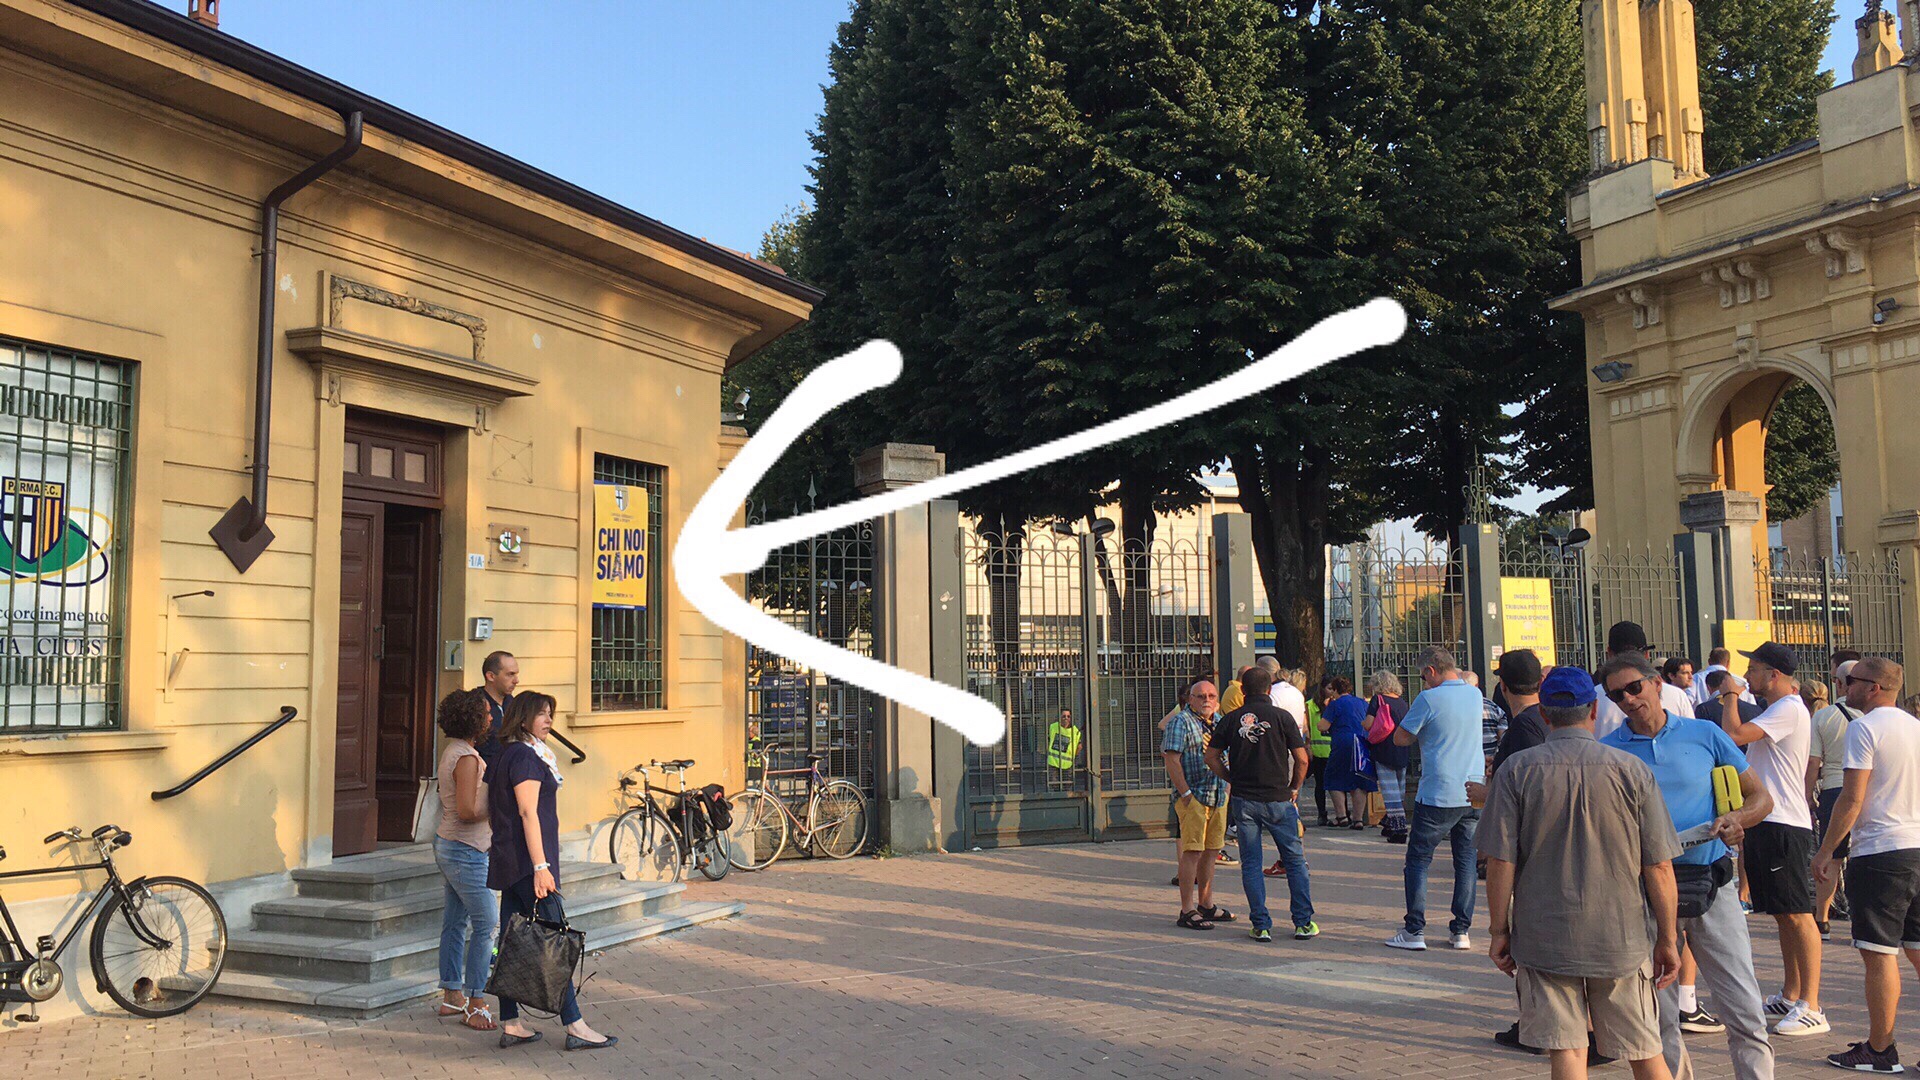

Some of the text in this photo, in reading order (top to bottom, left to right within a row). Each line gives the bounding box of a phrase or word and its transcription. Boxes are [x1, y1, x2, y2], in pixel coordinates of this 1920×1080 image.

[8, 481, 40, 493] PRMA
[598, 528, 645, 551] CHI NOI
[596, 552, 645, 581] SIAMO
